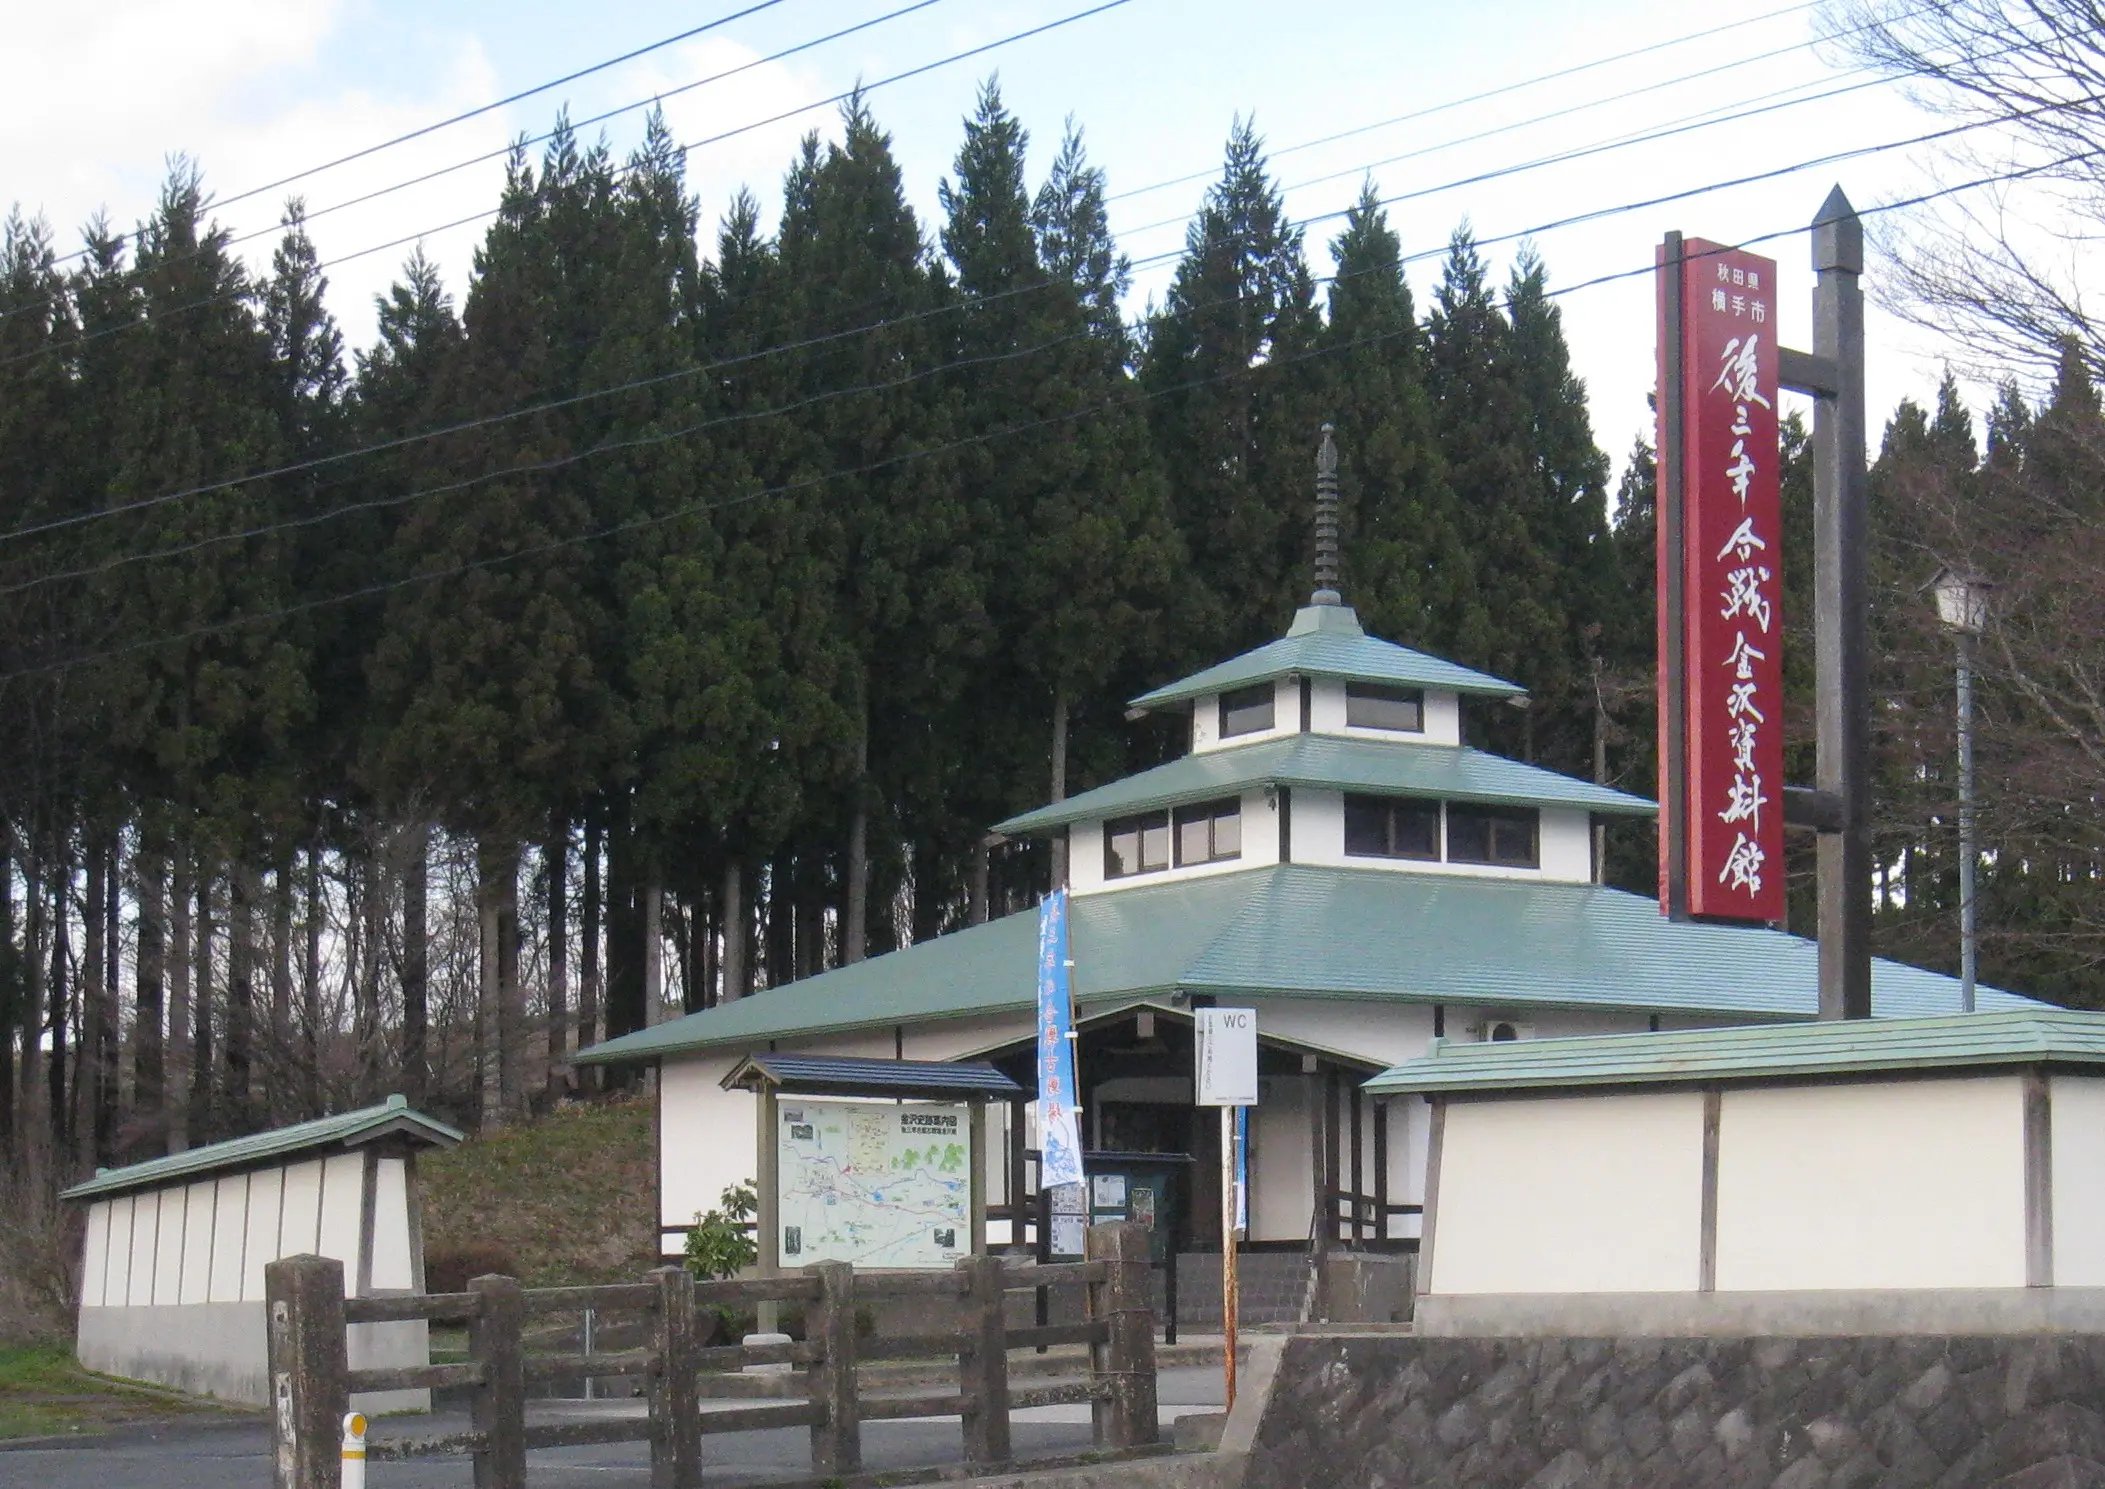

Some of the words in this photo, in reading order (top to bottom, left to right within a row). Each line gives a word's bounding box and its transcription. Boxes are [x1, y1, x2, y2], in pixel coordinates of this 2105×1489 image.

[1717, 263, 1759, 290] 秋田県
[1712, 288, 1765, 323] 横手市
[1223, 1014, 1247, 1029] WC
